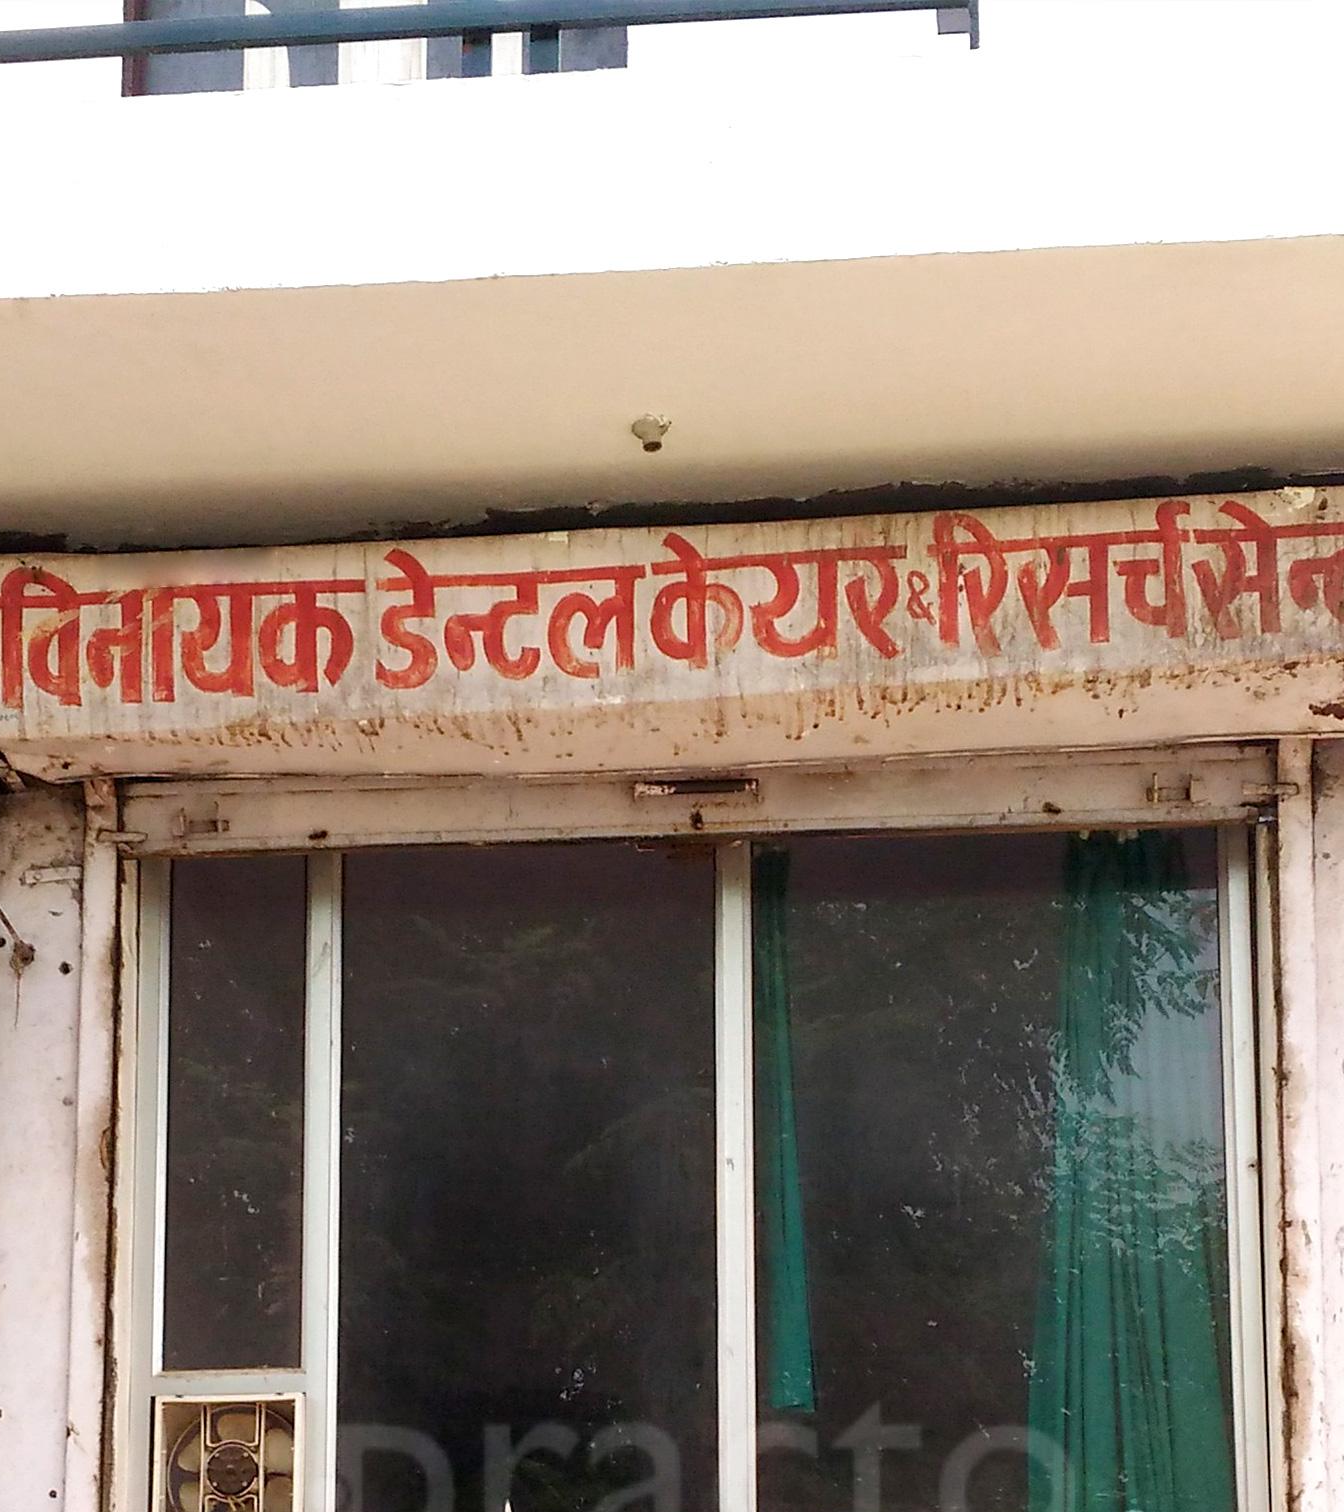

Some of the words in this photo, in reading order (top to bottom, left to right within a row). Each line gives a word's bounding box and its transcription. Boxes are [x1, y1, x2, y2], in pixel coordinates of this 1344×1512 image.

[377, 548, 647, 690] डेन्टल
[650, 531, 905, 669] केयर
[928, 501, 1191, 656] रिसर्च
